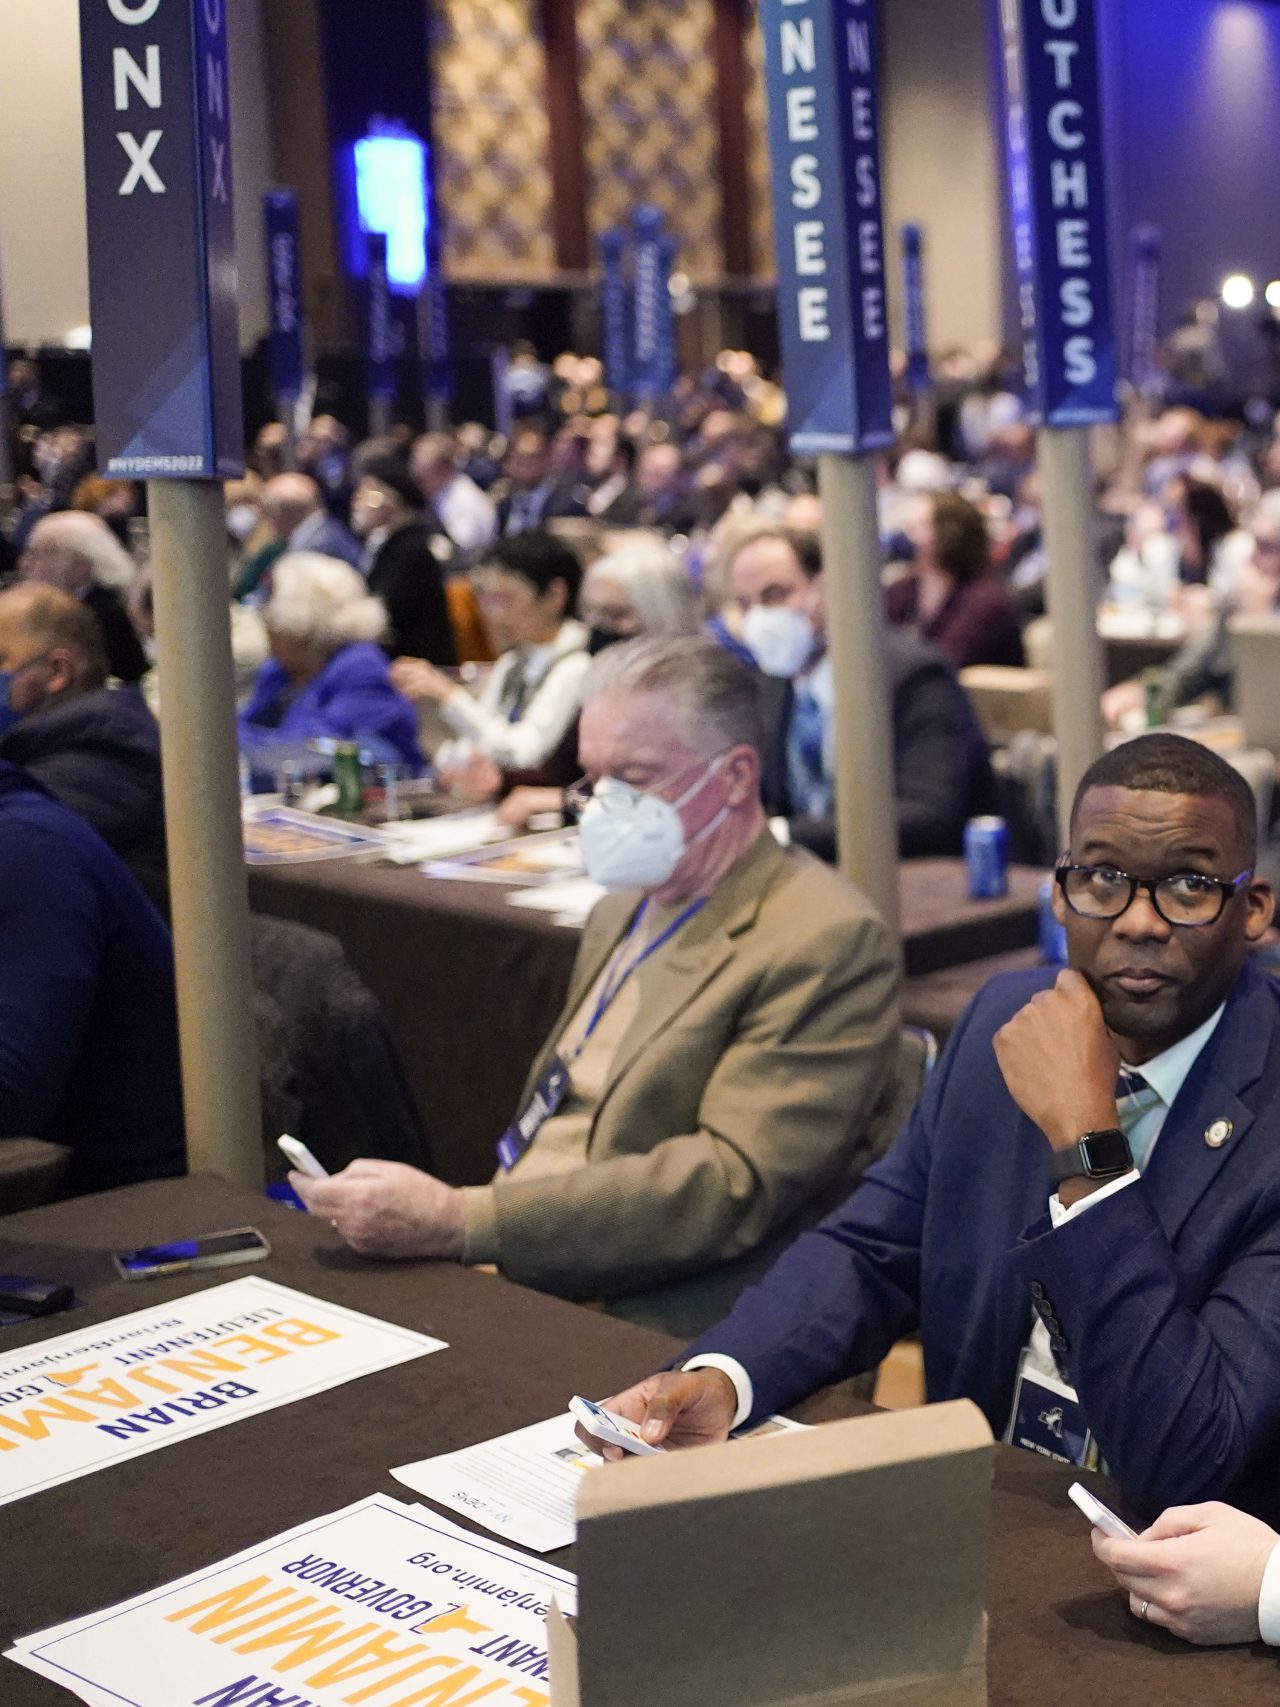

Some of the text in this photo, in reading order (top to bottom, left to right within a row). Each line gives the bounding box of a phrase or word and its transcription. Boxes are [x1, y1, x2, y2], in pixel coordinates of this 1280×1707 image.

[779, 0, 831, 342] NESEE
[845, 0, 883, 341] NESEE
[107, 455, 204, 473] #NYDEMS2022
[113, 1307, 285, 1367] LIEUTENANT
[96, 1380, 260, 1440] BRIAN
[281, 1553, 433, 1621] GOVERNOR
[406, 1552, 576, 1624] enjamin.org
